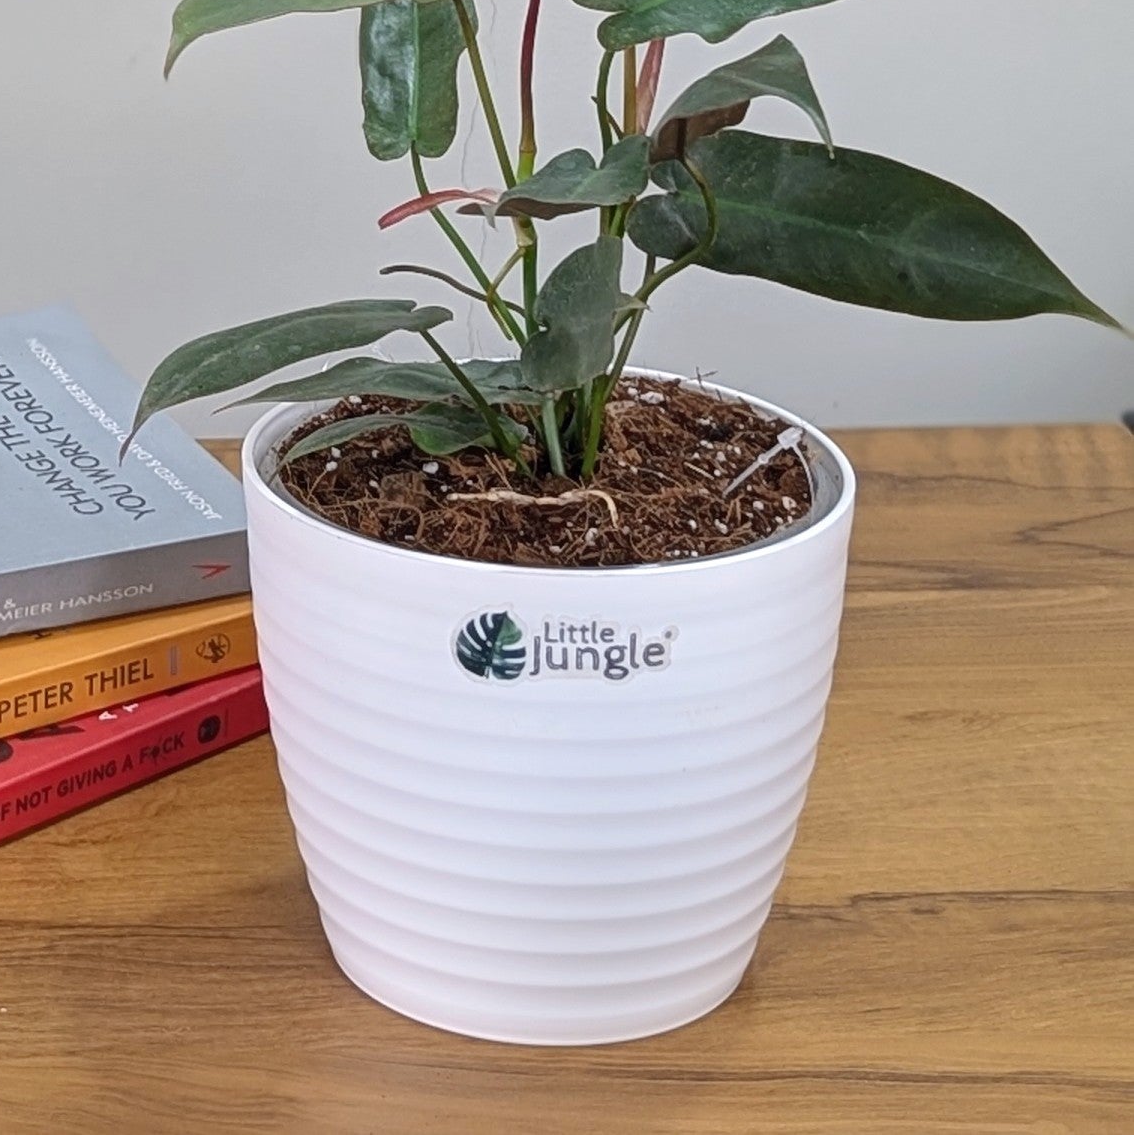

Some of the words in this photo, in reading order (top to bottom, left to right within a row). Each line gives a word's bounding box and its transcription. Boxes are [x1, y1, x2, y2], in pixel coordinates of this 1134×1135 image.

[26, 337, 73, 384] HANSSON
[46, 433, 116, 484] WORK
[15, 449, 104, 516] CHANGE
[154, 467, 188, 491] FRIED
[100, 484, 156, 521] YOU
[182, 490, 222, 520] JASON
[4, 599, 16, 609] &
[60, 583, 154, 610] HANSSON
[544, 621, 615, 644] Little
[529, 633, 665, 680] Jungle
[84, 658, 154, 696] THIEL
[16, 786, 53, 815] NOT
[57, 763, 117, 798] GIVING
[122, 754, 134, 774] A
